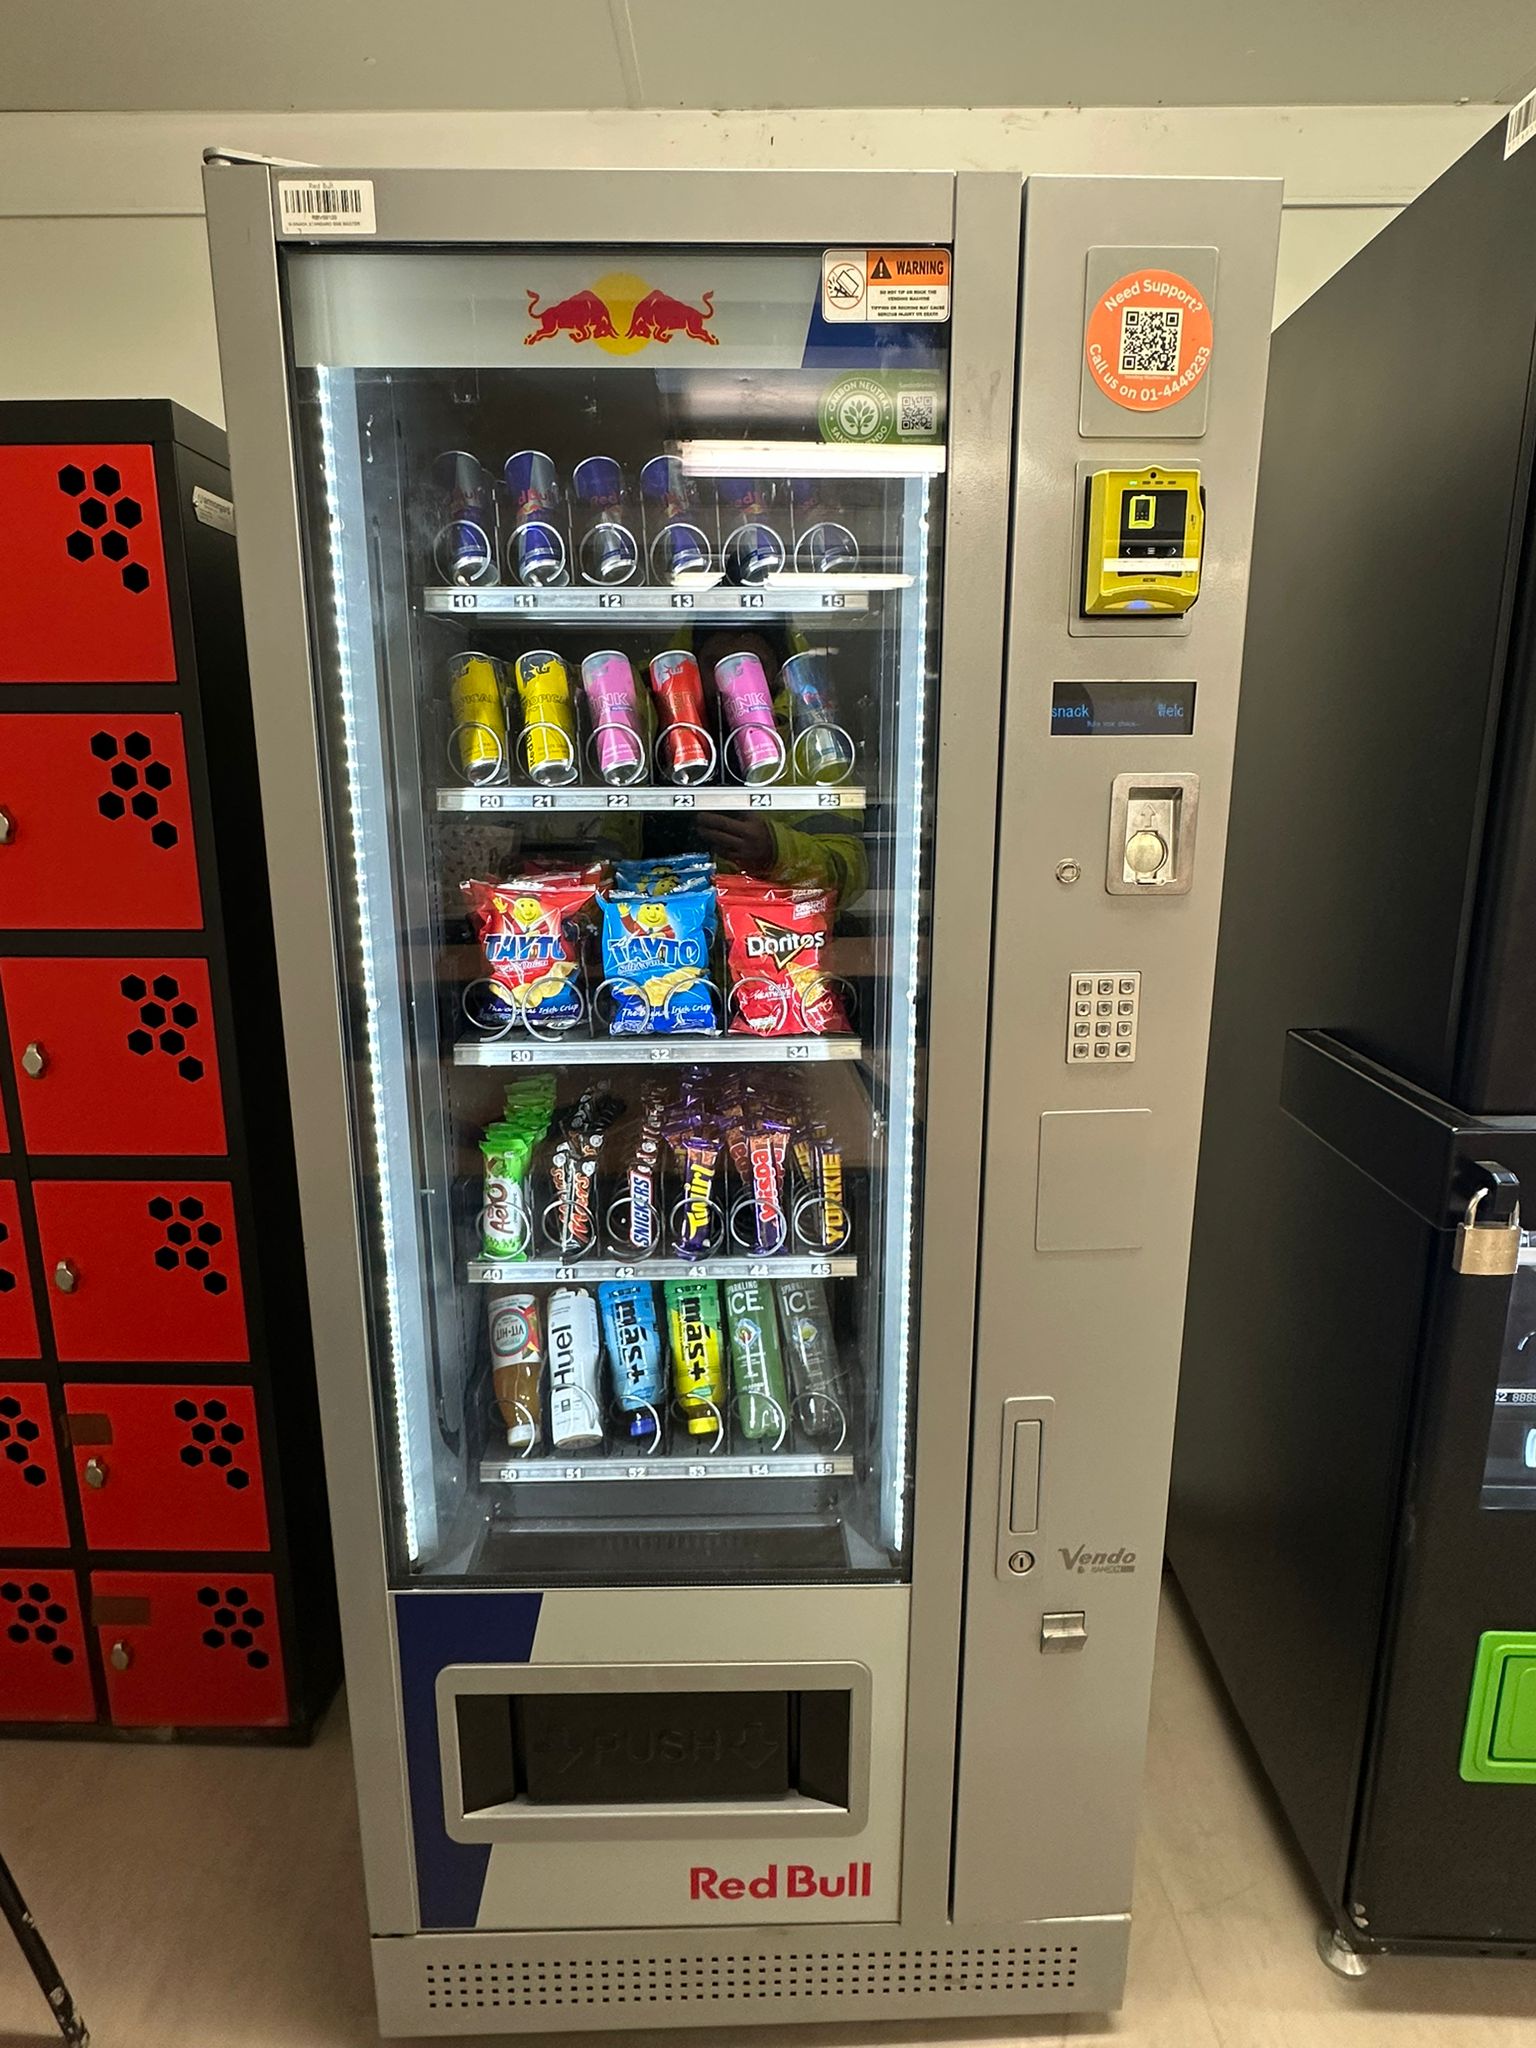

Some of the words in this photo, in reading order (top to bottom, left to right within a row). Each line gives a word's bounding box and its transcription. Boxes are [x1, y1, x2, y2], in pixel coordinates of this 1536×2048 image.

[896, 260, 944, 275] WARNING
[1104, 281, 1141, 312] Need
[1143, 279, 1203, 313] Support?
[1089, 344, 1109, 375] Call
[1103, 373, 1120, 389] us
[1119, 384, 1137, 399] on
[1140, 346, 1210, 401] 01-4448233
[829, 381, 857, 412] CARBON
[859, 381, 891, 411] NEUTRAL
[455, 596, 474, 607] 10
[516, 595, 535, 607] 11
[601, 595, 621, 607] 12
[673, 595, 693, 607] 13
[743, 595, 763, 607] 14
[824, 594, 844, 607] 15
[1051, 704, 1089, 718] snack
[481, 795, 500, 807] 20
[534, 795, 552, 807] 21
[609, 795, 628, 807] 22
[674, 795, 694, 806] 23
[751, 795, 771, 806] 24
[820, 795, 839, 806] 25
[607, 936, 700, 966] TAYTO
[747, 931, 825, 957] Doritos
[560, 1003, 579, 1013] Crisp
[622, 1008, 639, 1016] The
[671, 1005, 690, 1015] Irish
[692, 1004, 711, 1014] Crisp
[512, 1051, 530, 1061] 30
[651, 1049, 670, 1060] 32
[789, 1046, 808, 1058] 34
[752, 1149, 778, 1222] Wispa
[823, 1153, 844, 1245] YORKIE
[569, 1171, 590, 1243] Mars
[633, 1176, 650, 1247] SNICKERS
[685, 1163, 715, 1239] Twirl
[483, 1269, 501, 1279] 40
[556, 1268, 574, 1279] 41
[616, 1267, 634, 1278] 42
[688, 1266, 706, 1276] 43
[750, 1266, 769, 1276] 44
[812, 1265, 831, 1275] 45
[782, 1290, 818, 1316] ICE
[552, 1324, 576, 1392] Huel
[501, 1470, 517, 1480] 50
[566, 1469, 582, 1478] 51
[629, 1468, 645, 1478] 52
[689, 1466, 706, 1476] 53
[752, 1465, 768, 1475] 54
[816, 1464, 833, 1473] 55
[1058, 1544, 1136, 1570] Vendo
[594, 1728, 722, 1768] PUSH
[690, 1864, 777, 1900] Red
[786, 1862, 872, 1898] Bull
